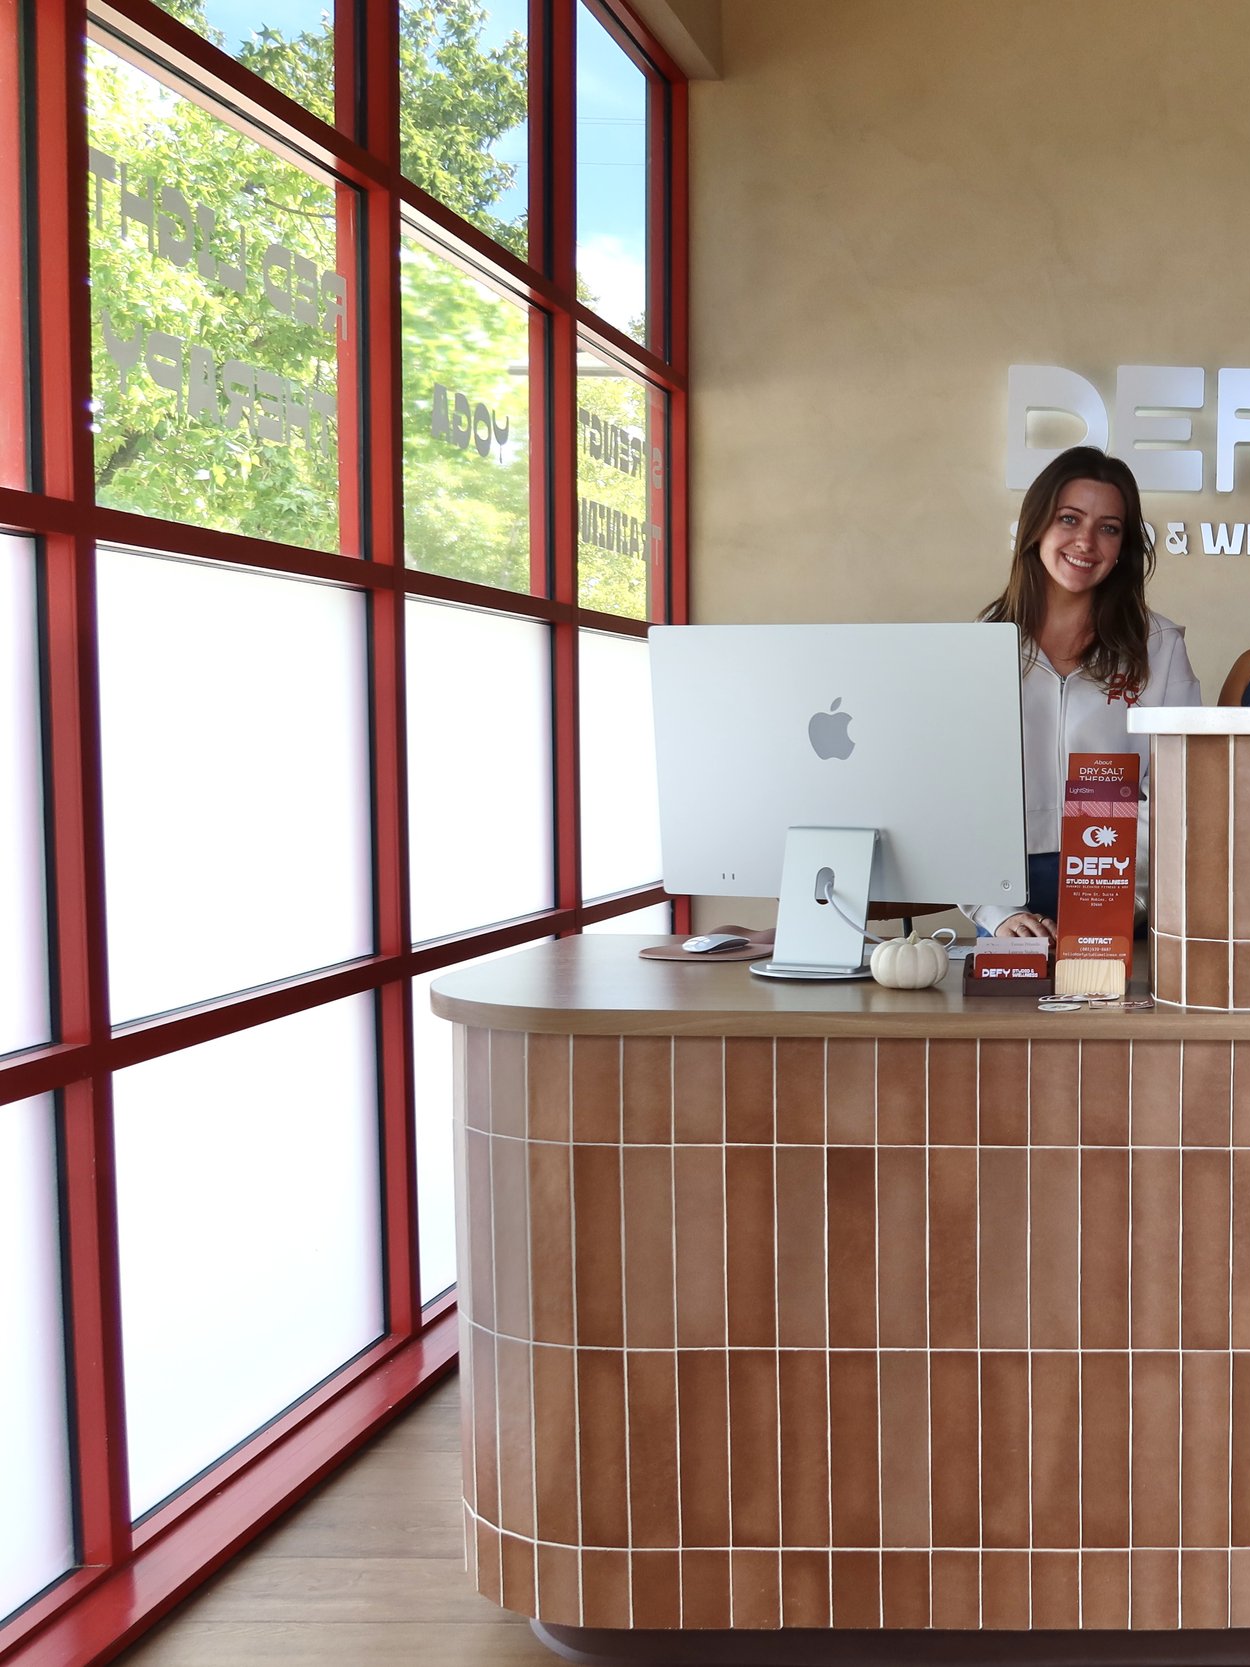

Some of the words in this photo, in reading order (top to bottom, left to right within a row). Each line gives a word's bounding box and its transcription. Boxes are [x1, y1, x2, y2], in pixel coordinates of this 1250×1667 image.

[1165, 522, 1189, 555] &
[1079, 767, 1099, 775] DRY
[1101, 767, 1124, 775] SALT
[1066, 856, 1130, 876] DEFY
[1077, 937, 1113, 945] CONTACT
[981, 968, 1011, 978] DEFY
